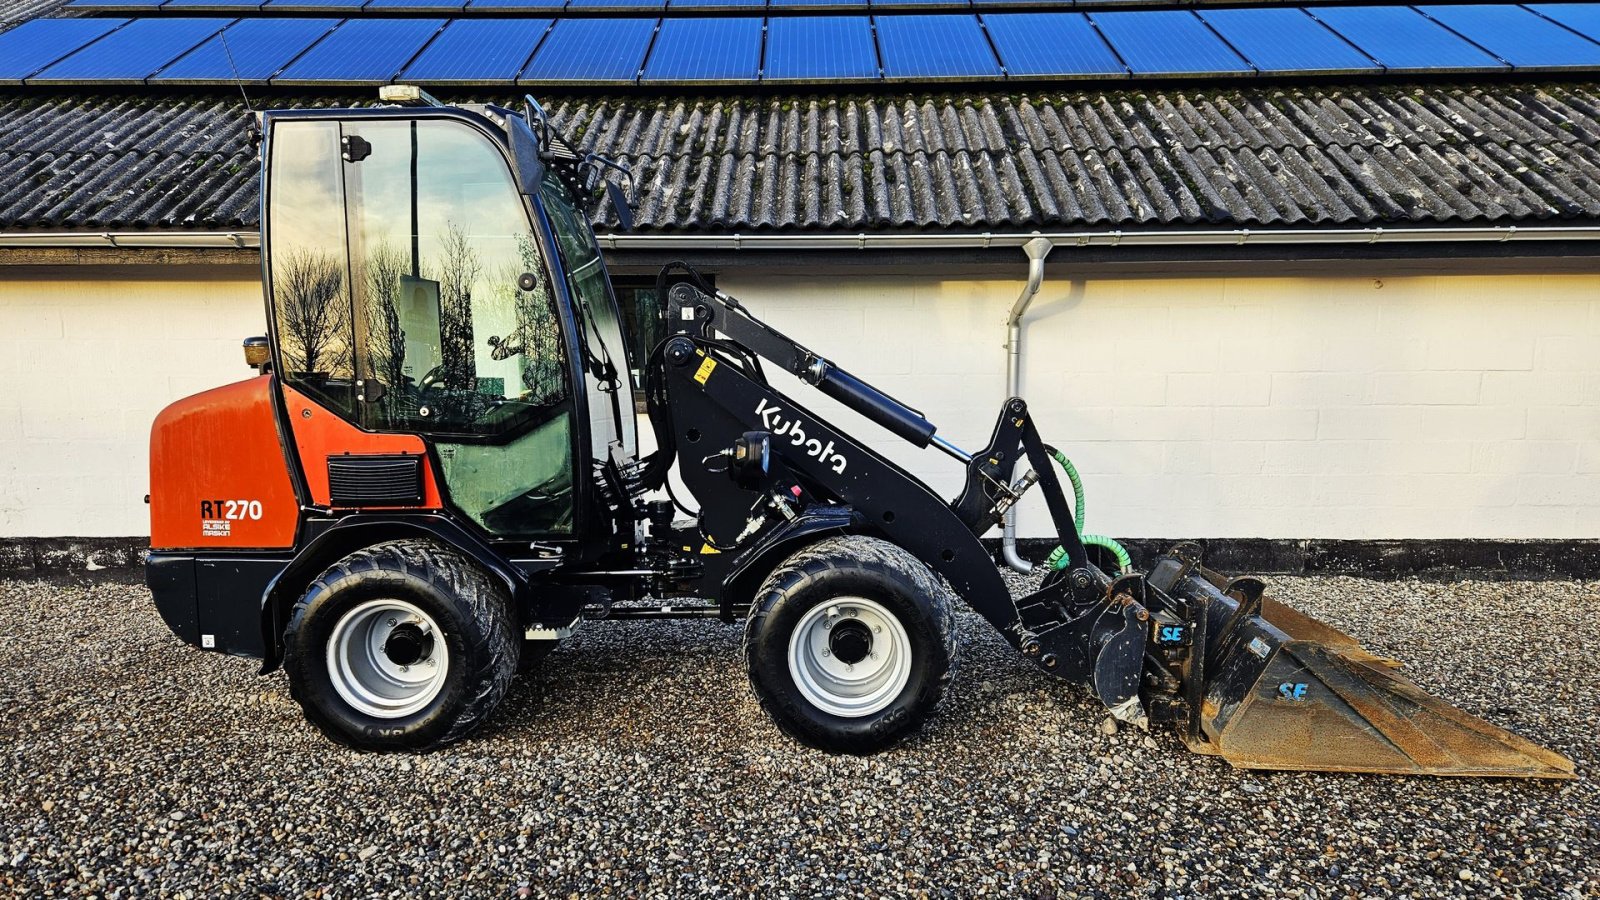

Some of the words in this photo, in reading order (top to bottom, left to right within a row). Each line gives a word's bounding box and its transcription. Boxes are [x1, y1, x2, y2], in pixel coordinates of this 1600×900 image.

[755, 398, 847, 474] Kubota
[201, 500, 263, 520] RT270
[1161, 627, 1184, 642] SE
[1278, 682, 1309, 701] SE
